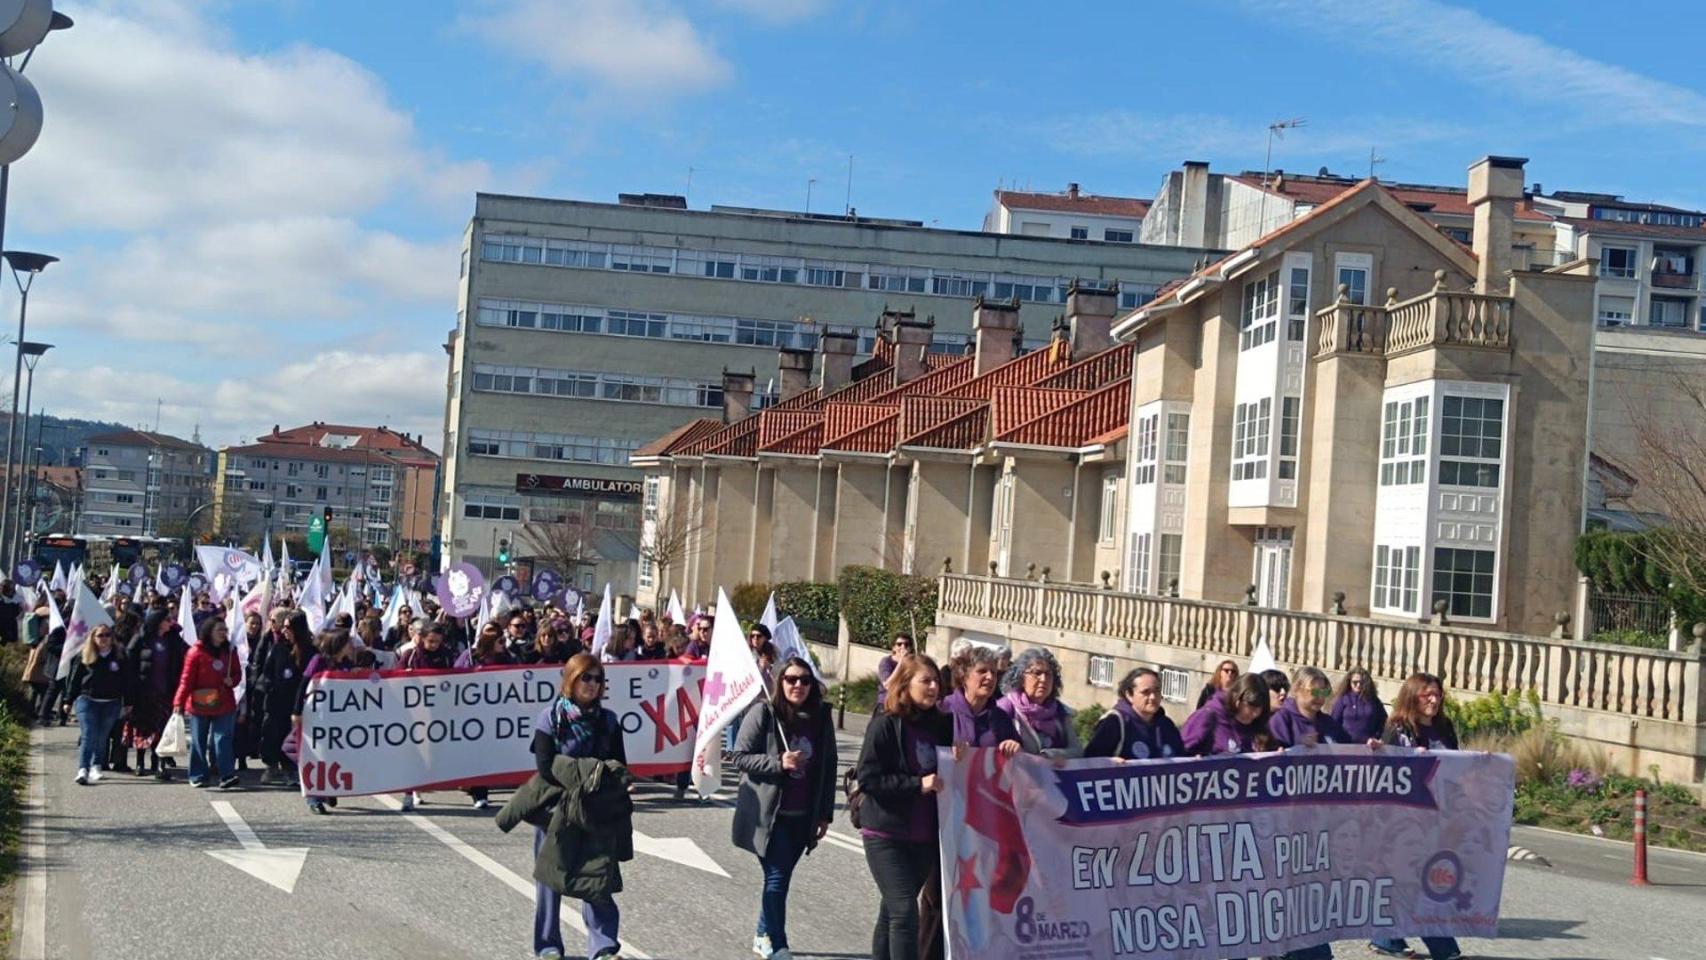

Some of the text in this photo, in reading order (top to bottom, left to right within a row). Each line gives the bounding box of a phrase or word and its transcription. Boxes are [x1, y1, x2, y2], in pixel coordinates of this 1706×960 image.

[312, 687, 383, 713] PLAN
[404, 684, 436, 708] DE
[312, 716, 530, 750] PROTOCOLO DE
[302, 761, 353, 791] CIG
[1076, 764, 1412, 812] FEMINISTAS E COMBATIVAS
[1072, 822, 1331, 889] EN LOITA POLA
[1015, 896, 1037, 944] 8
[1038, 921, 1091, 940] MARZO
[1110, 877, 1395, 954] NOSA DIGNIDADE
